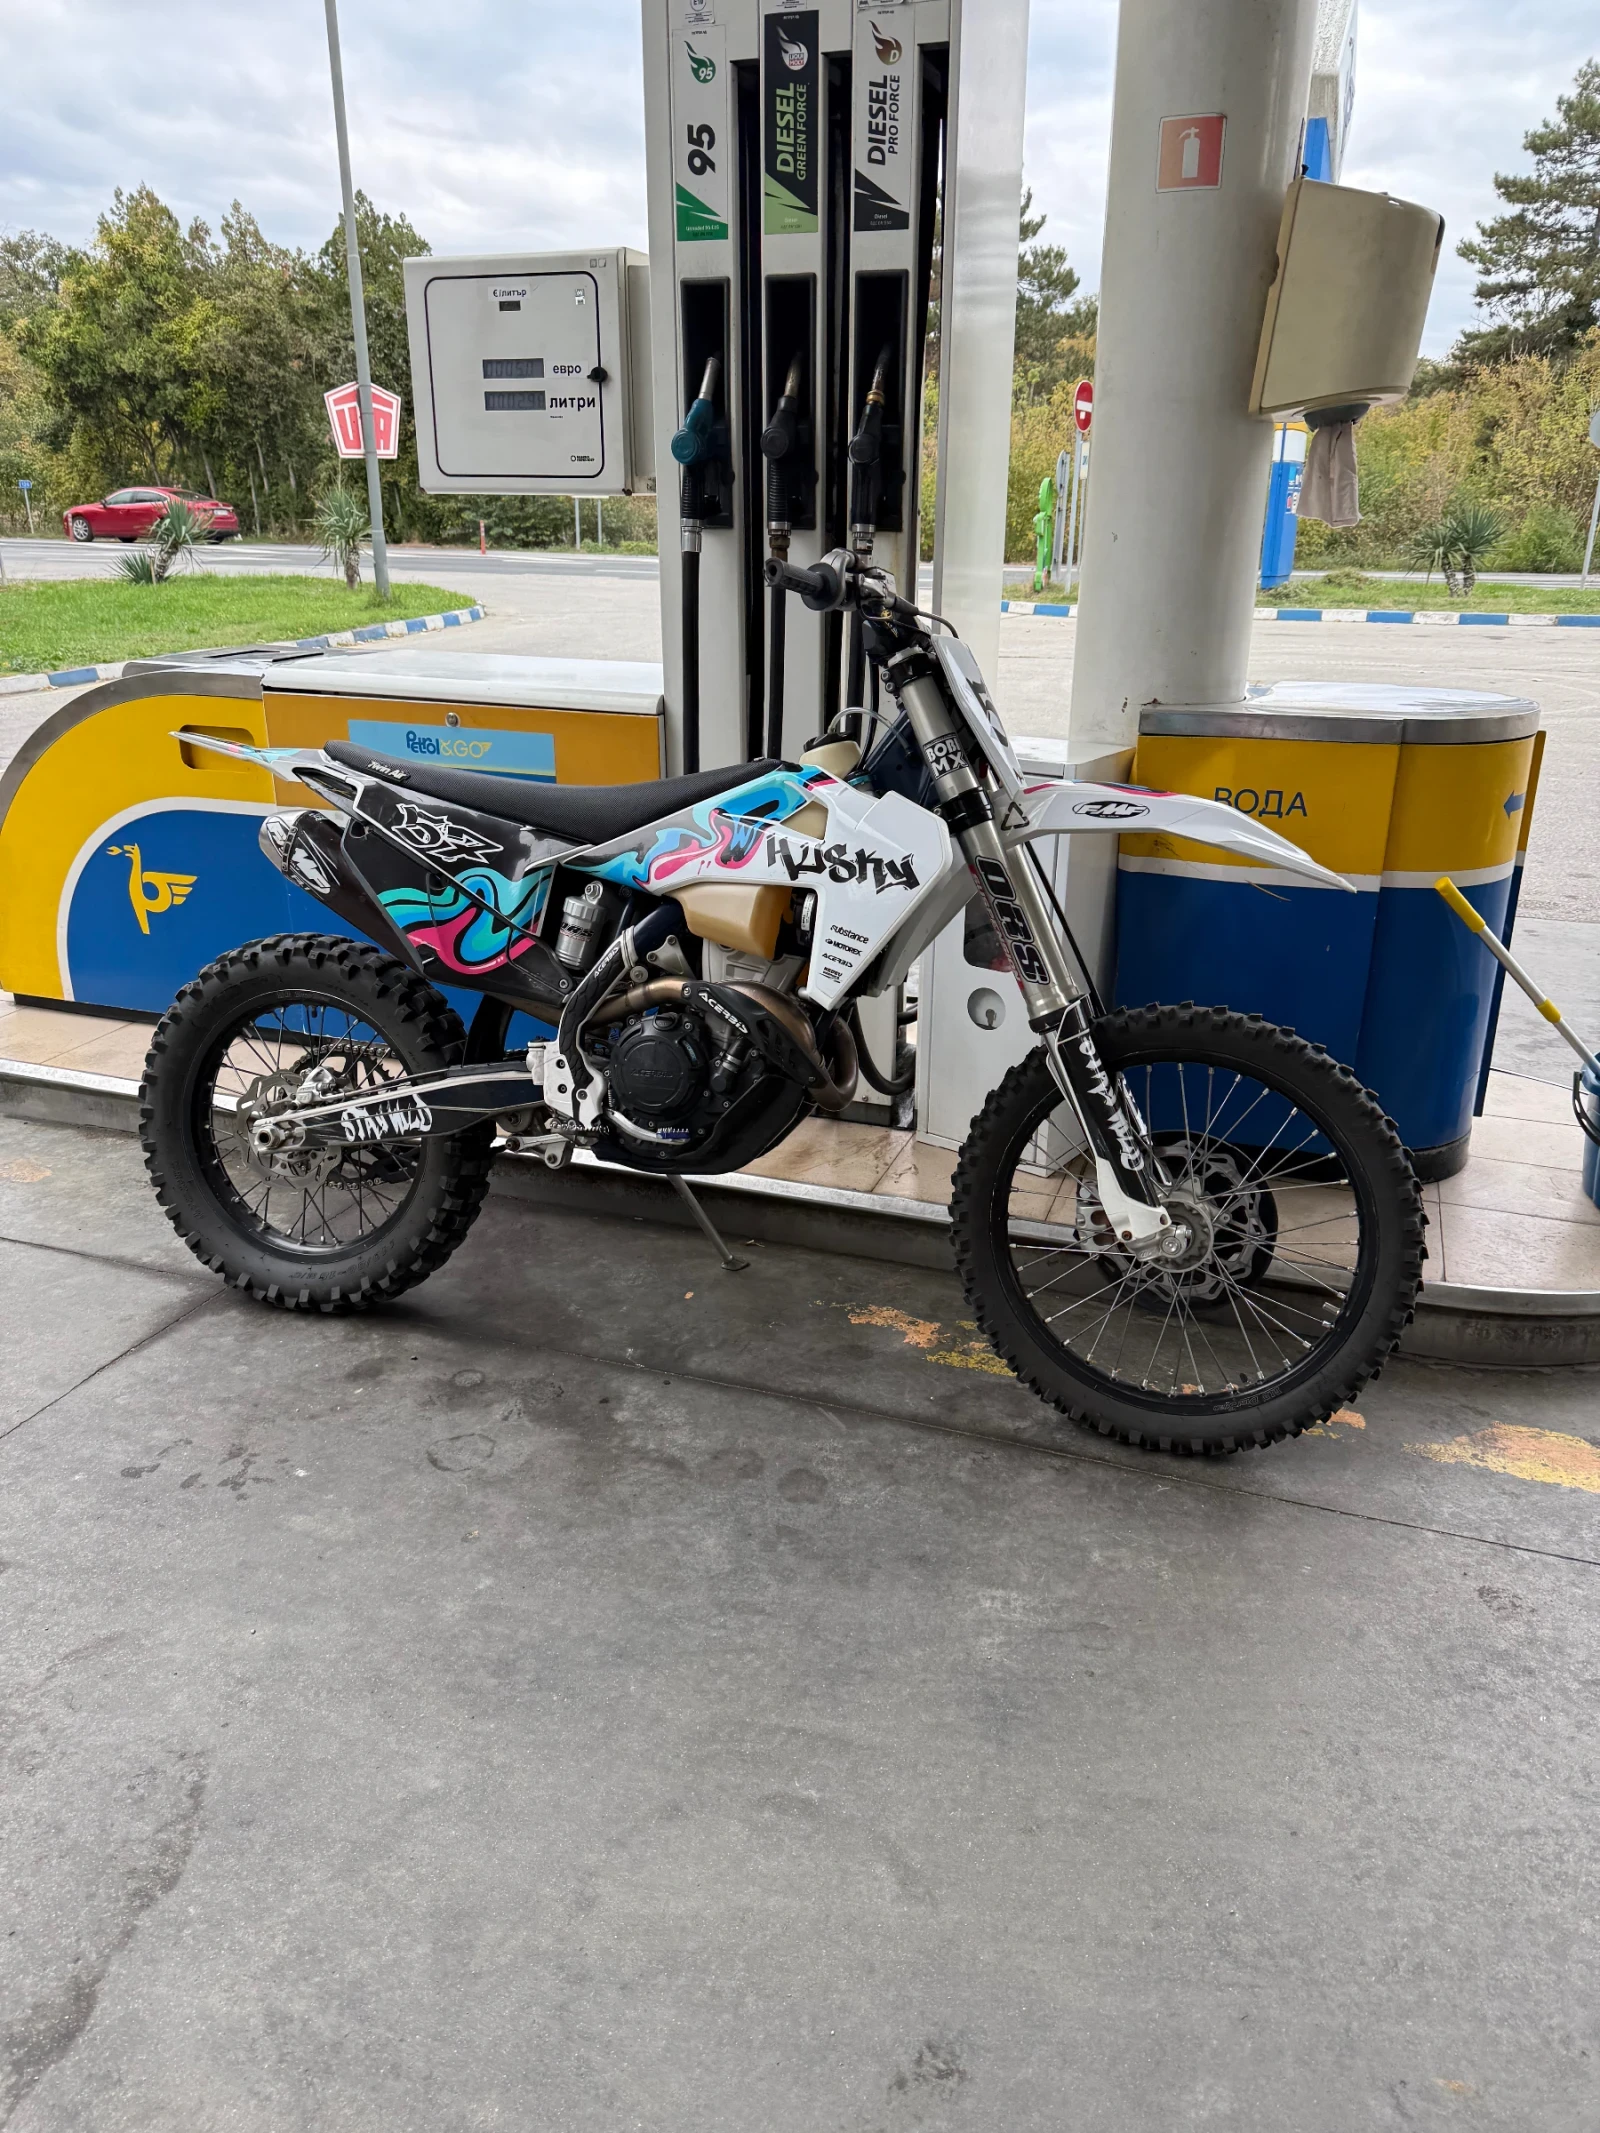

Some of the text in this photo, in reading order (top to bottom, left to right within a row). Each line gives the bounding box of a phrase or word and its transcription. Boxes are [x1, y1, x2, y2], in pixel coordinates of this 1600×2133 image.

[889, 51, 899, 62] D
[699, 67, 713, 80] 95
[868, 75, 887, 165] DIESEL
[888, 75, 900, 154] PRO FORCE
[776, 83, 795, 173] DIESEL
[797, 84, 806, 180] GREEN FORCE
[687, 123, 715, 176] 95
[553, 365, 582, 376] евро
[550, 397, 596, 411] литри
[925, 738, 961, 763] BOBI
[931, 752, 967, 777] MX
[1214, 787, 1307, 818] ВОДА
[830, 924, 869, 944] substance
[833, 941, 863, 956] MOTOREX
[699, 990, 748, 1034] ACERBIS
